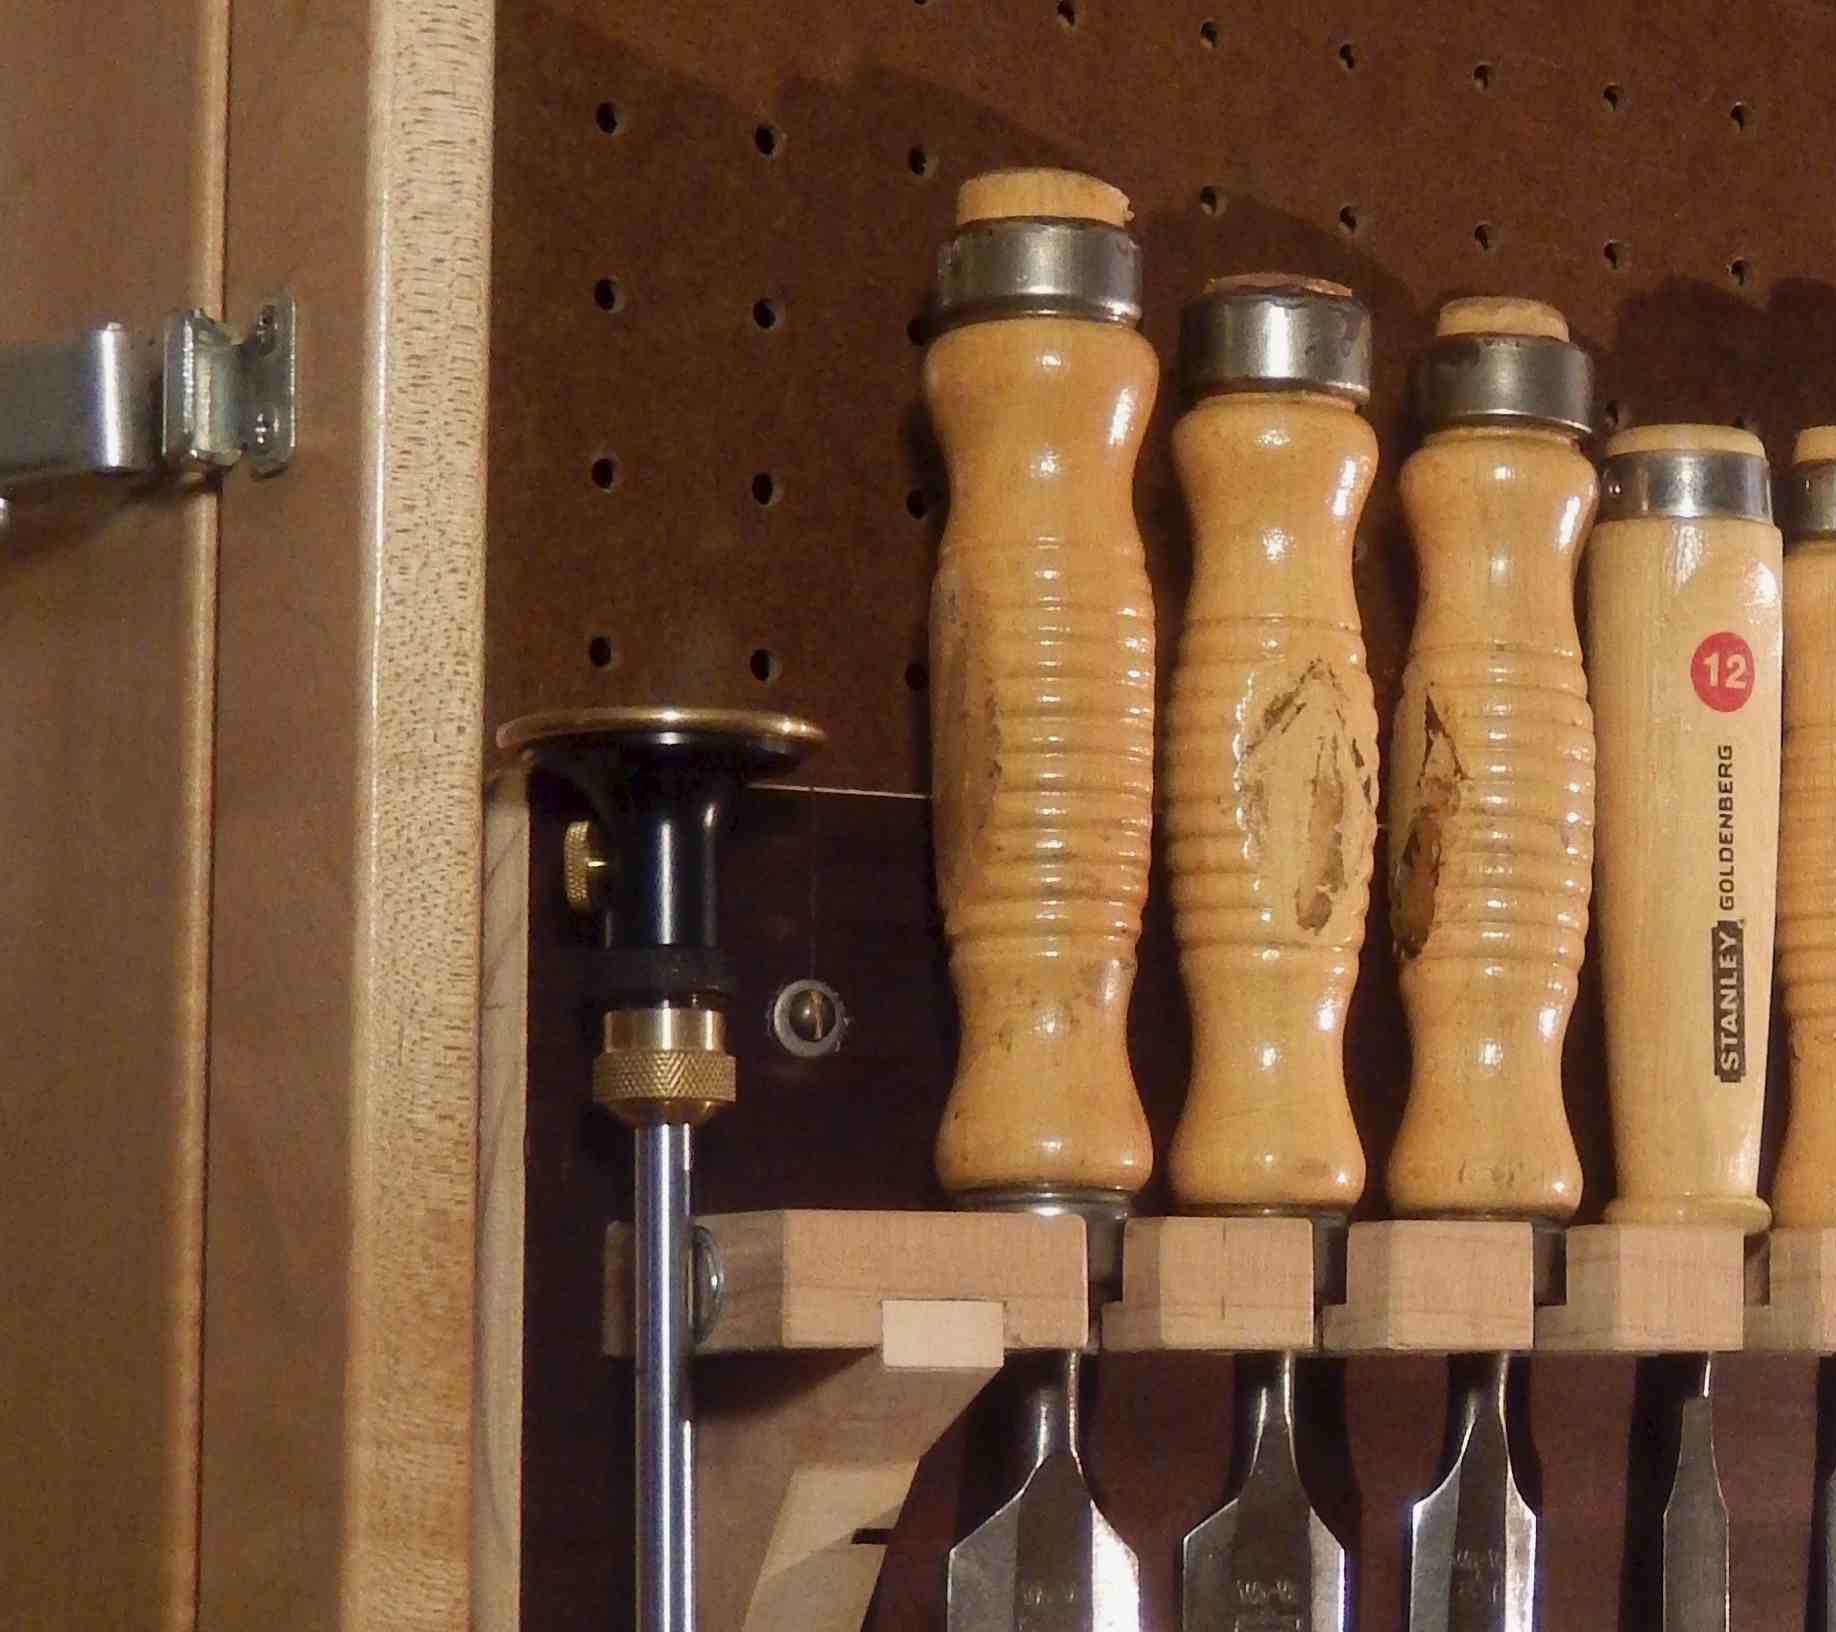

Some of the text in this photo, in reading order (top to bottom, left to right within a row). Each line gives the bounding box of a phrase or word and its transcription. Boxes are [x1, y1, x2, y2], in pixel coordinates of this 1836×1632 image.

[1702, 652, 1748, 689] 12
[1717, 744, 1740, 1072] STANLEY GOLDENBERG
